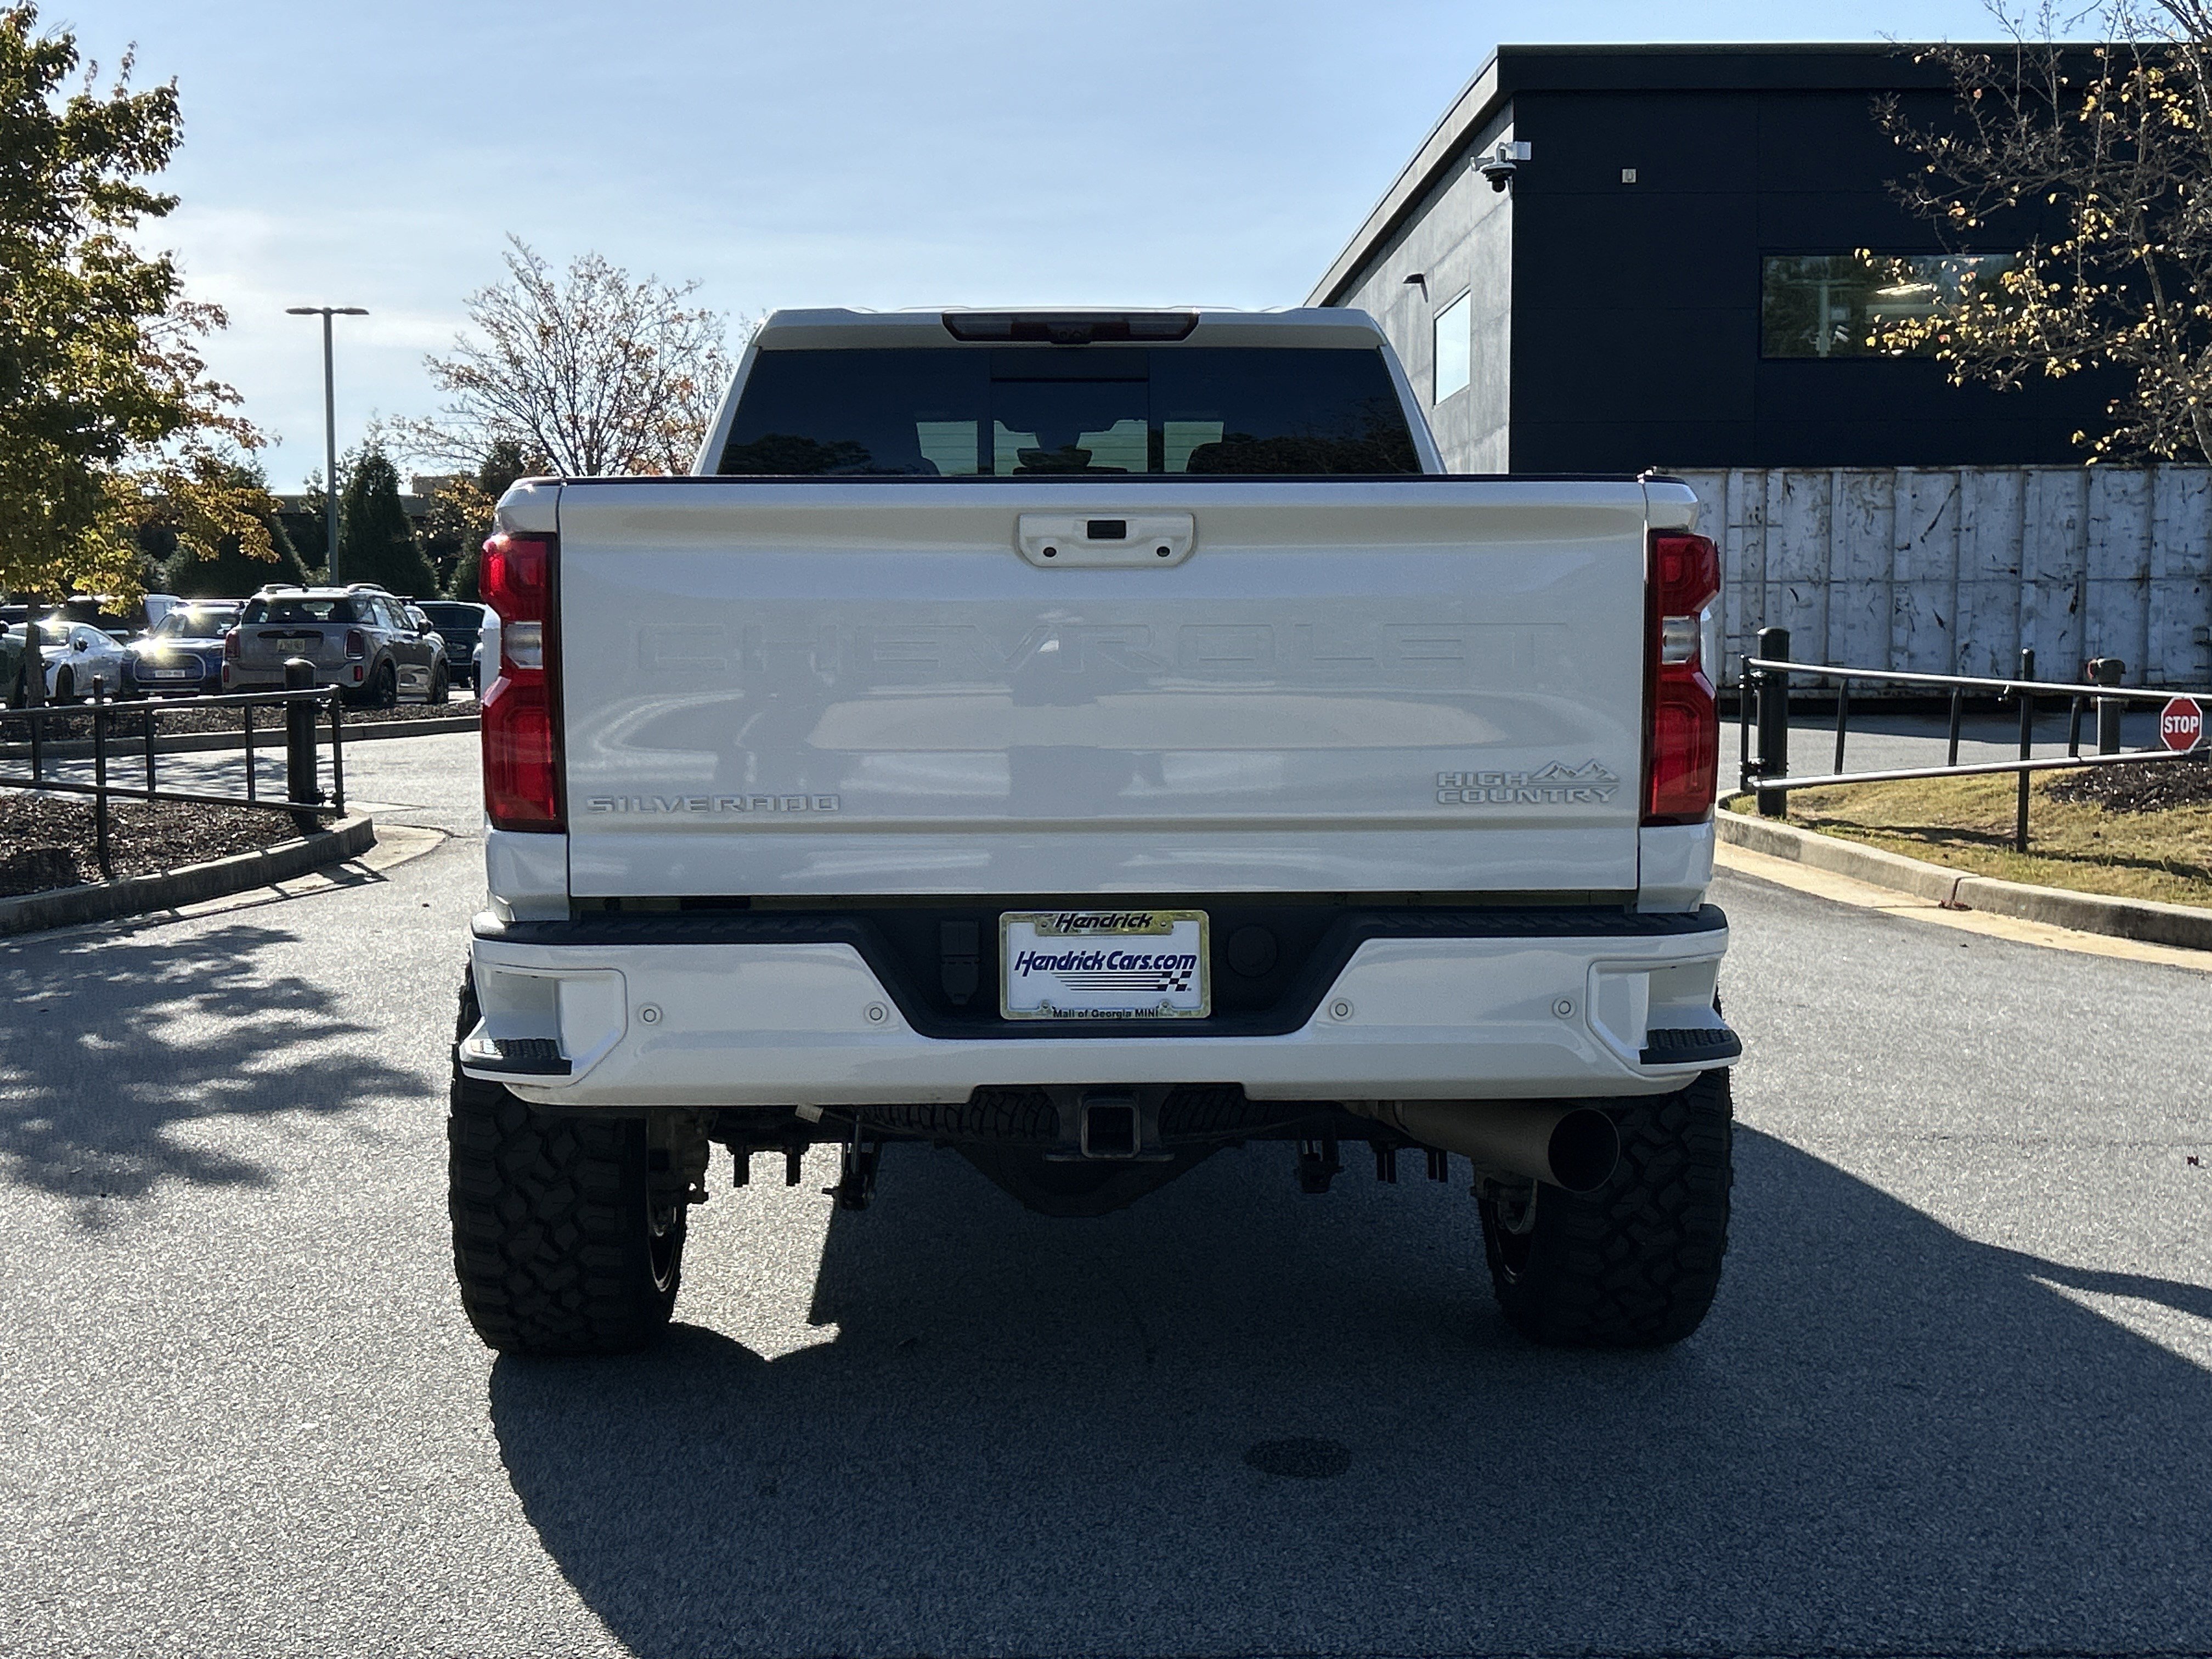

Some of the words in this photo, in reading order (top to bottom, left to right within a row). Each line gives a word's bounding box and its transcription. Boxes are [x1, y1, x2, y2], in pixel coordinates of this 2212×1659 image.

[629, 622, 1568, 673] CHEVROLET
[2164, 715, 2199, 734] STOP
[1437, 771, 1529, 787] HIGH
[586, 794, 840, 813] SILVERADO
[1437, 788, 1617, 803] COUNTRY
[1056, 913, 1153, 933] Hendrick
[1053, 1009, 1075, 1018] Mall
[1078, 1009, 1088, 1018] of
[1091, 1008, 1131, 1019] Georgia
[1135, 1009, 1159, 1018] MINI
